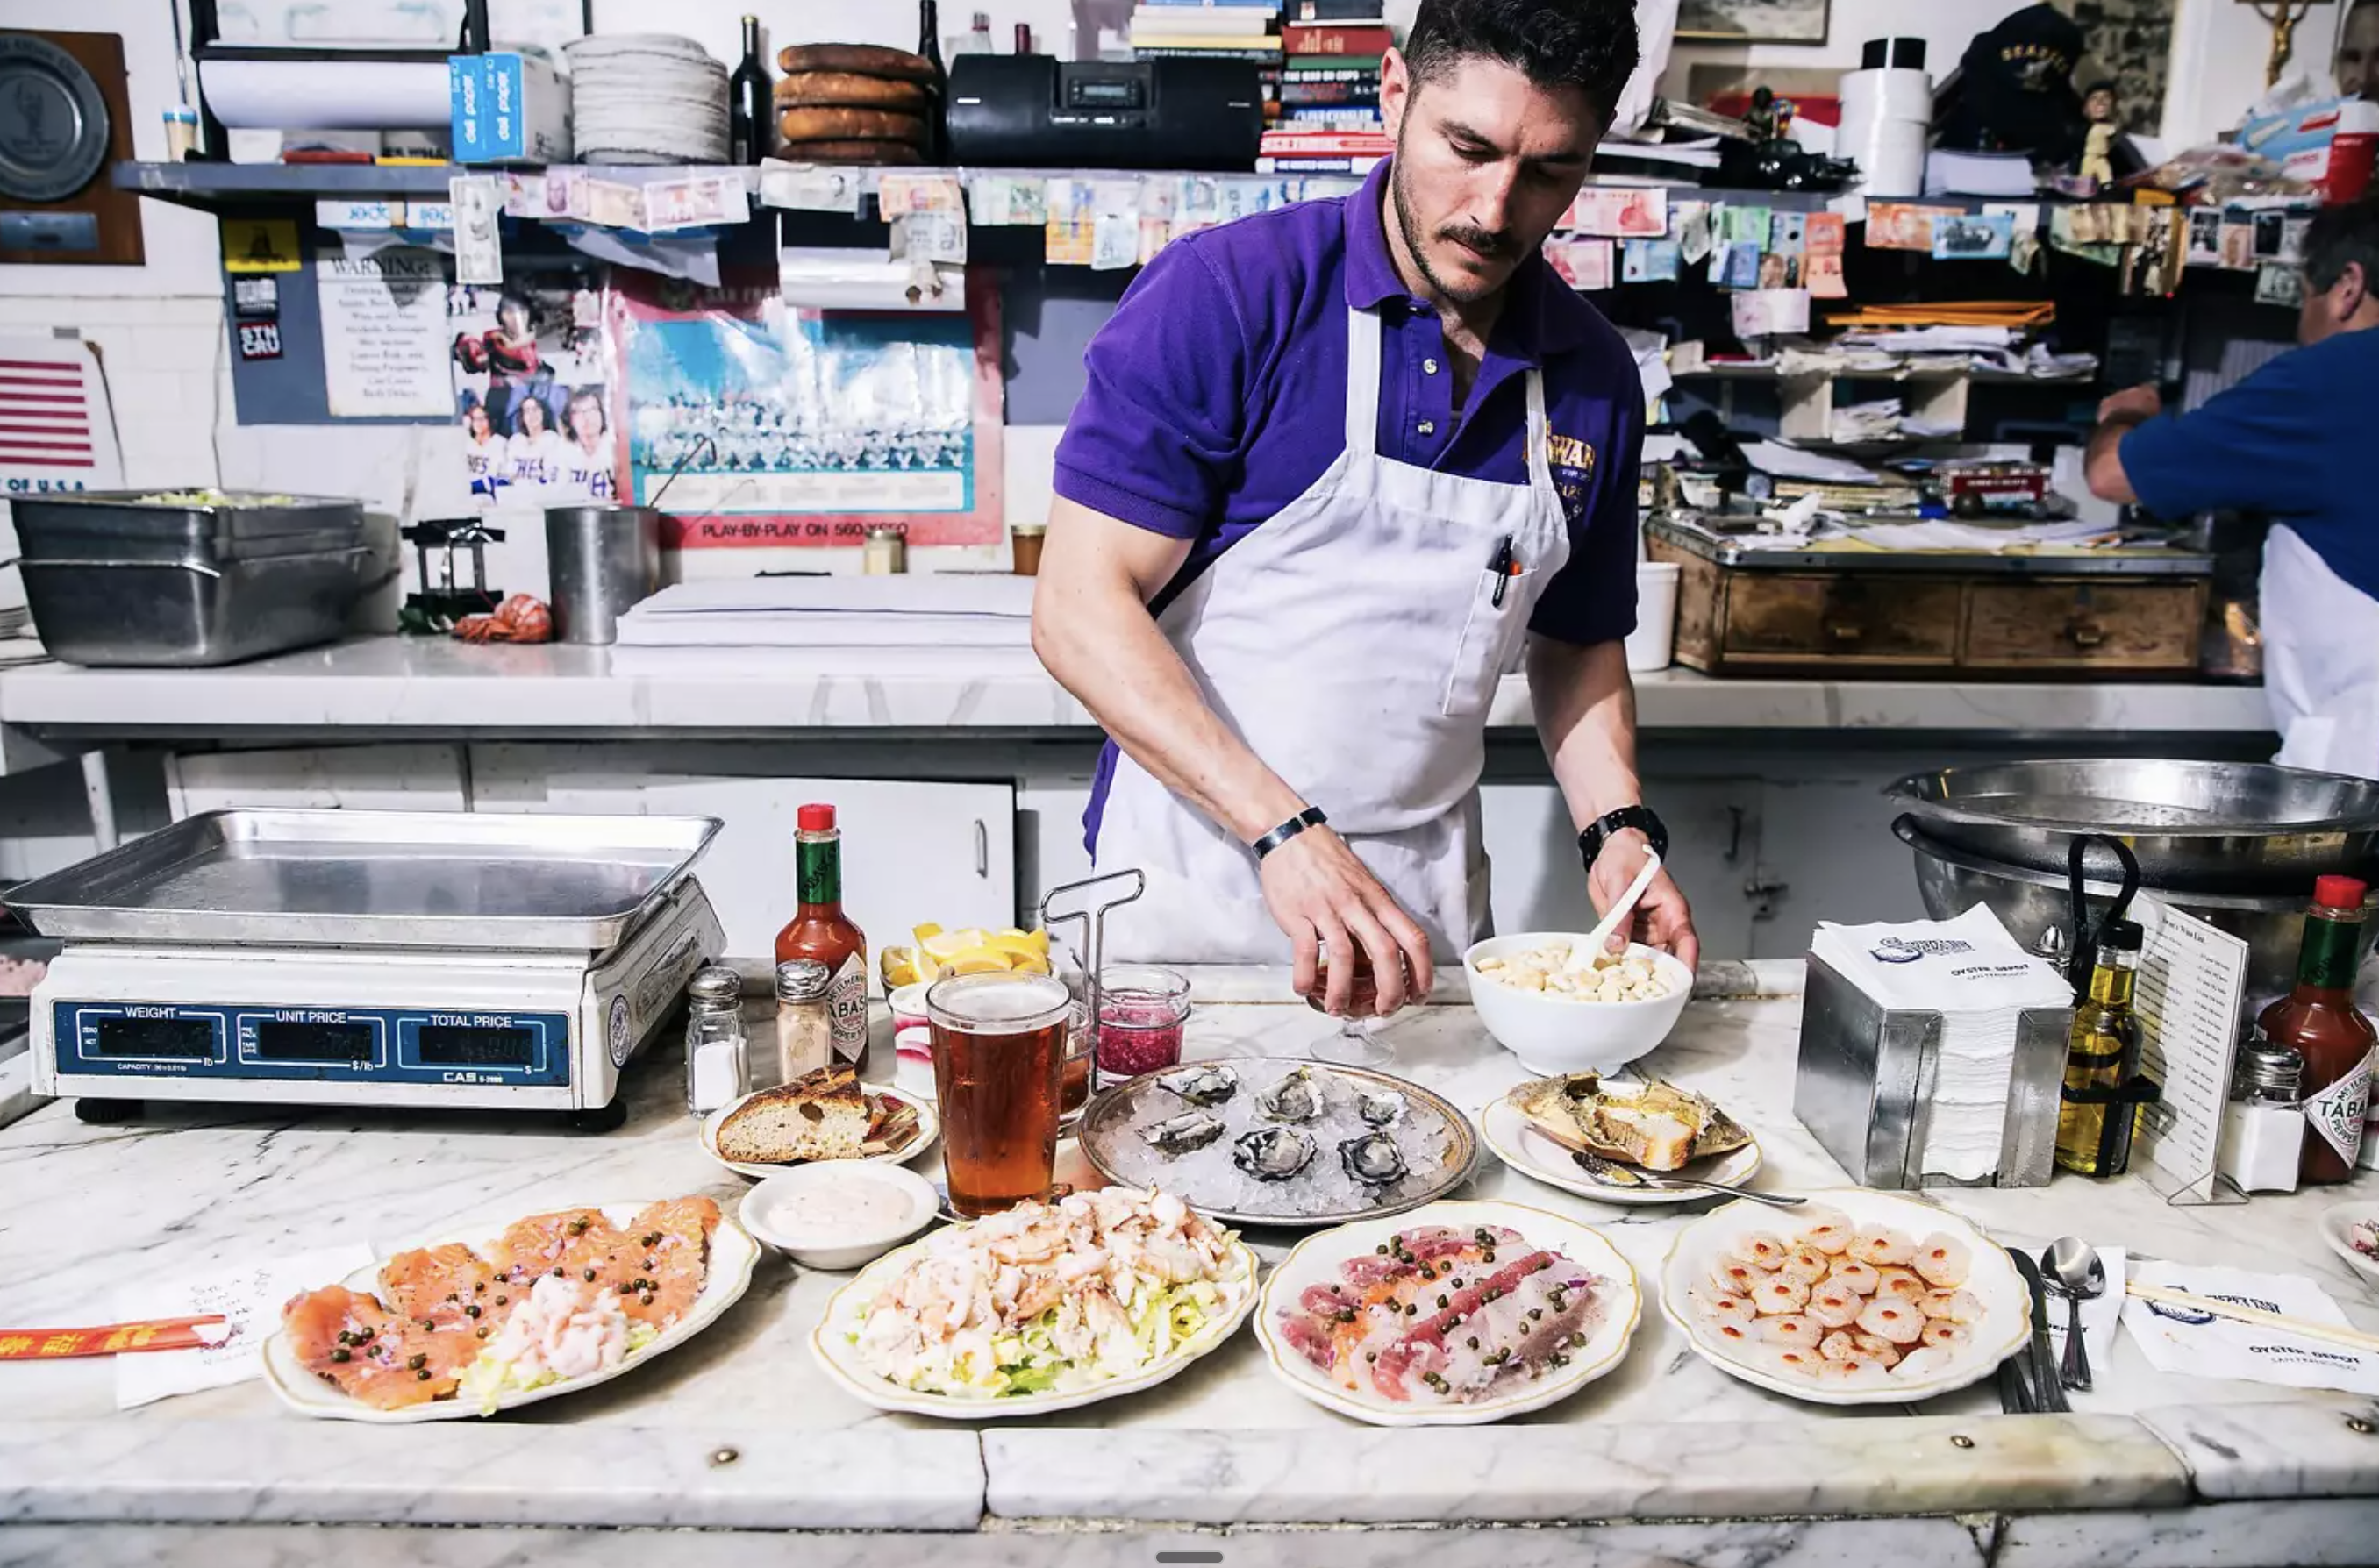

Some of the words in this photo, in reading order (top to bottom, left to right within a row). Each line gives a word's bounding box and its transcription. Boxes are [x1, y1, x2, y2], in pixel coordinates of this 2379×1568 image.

[703, 523, 801, 538] PLAY-BY-PLAY
[806, 524, 828, 537] ON
[125, 1007, 175, 1019] WEIGHT
[276, 1011, 306, 1022] UNIT
[309, 1012, 346, 1023] PRICE
[431, 1015, 471, 1026] TOTAL
[474, 1016, 511, 1028] PRICE
[118, 1062, 151, 1071] CAPACITY
[204, 1057, 213, 1066] lb
[353, 1060, 374, 1072] $/lb
[525, 1065, 532, 1075] $
[443, 1072, 477, 1083] CAS
[2249, 1344, 2304, 1355] OYSTER
